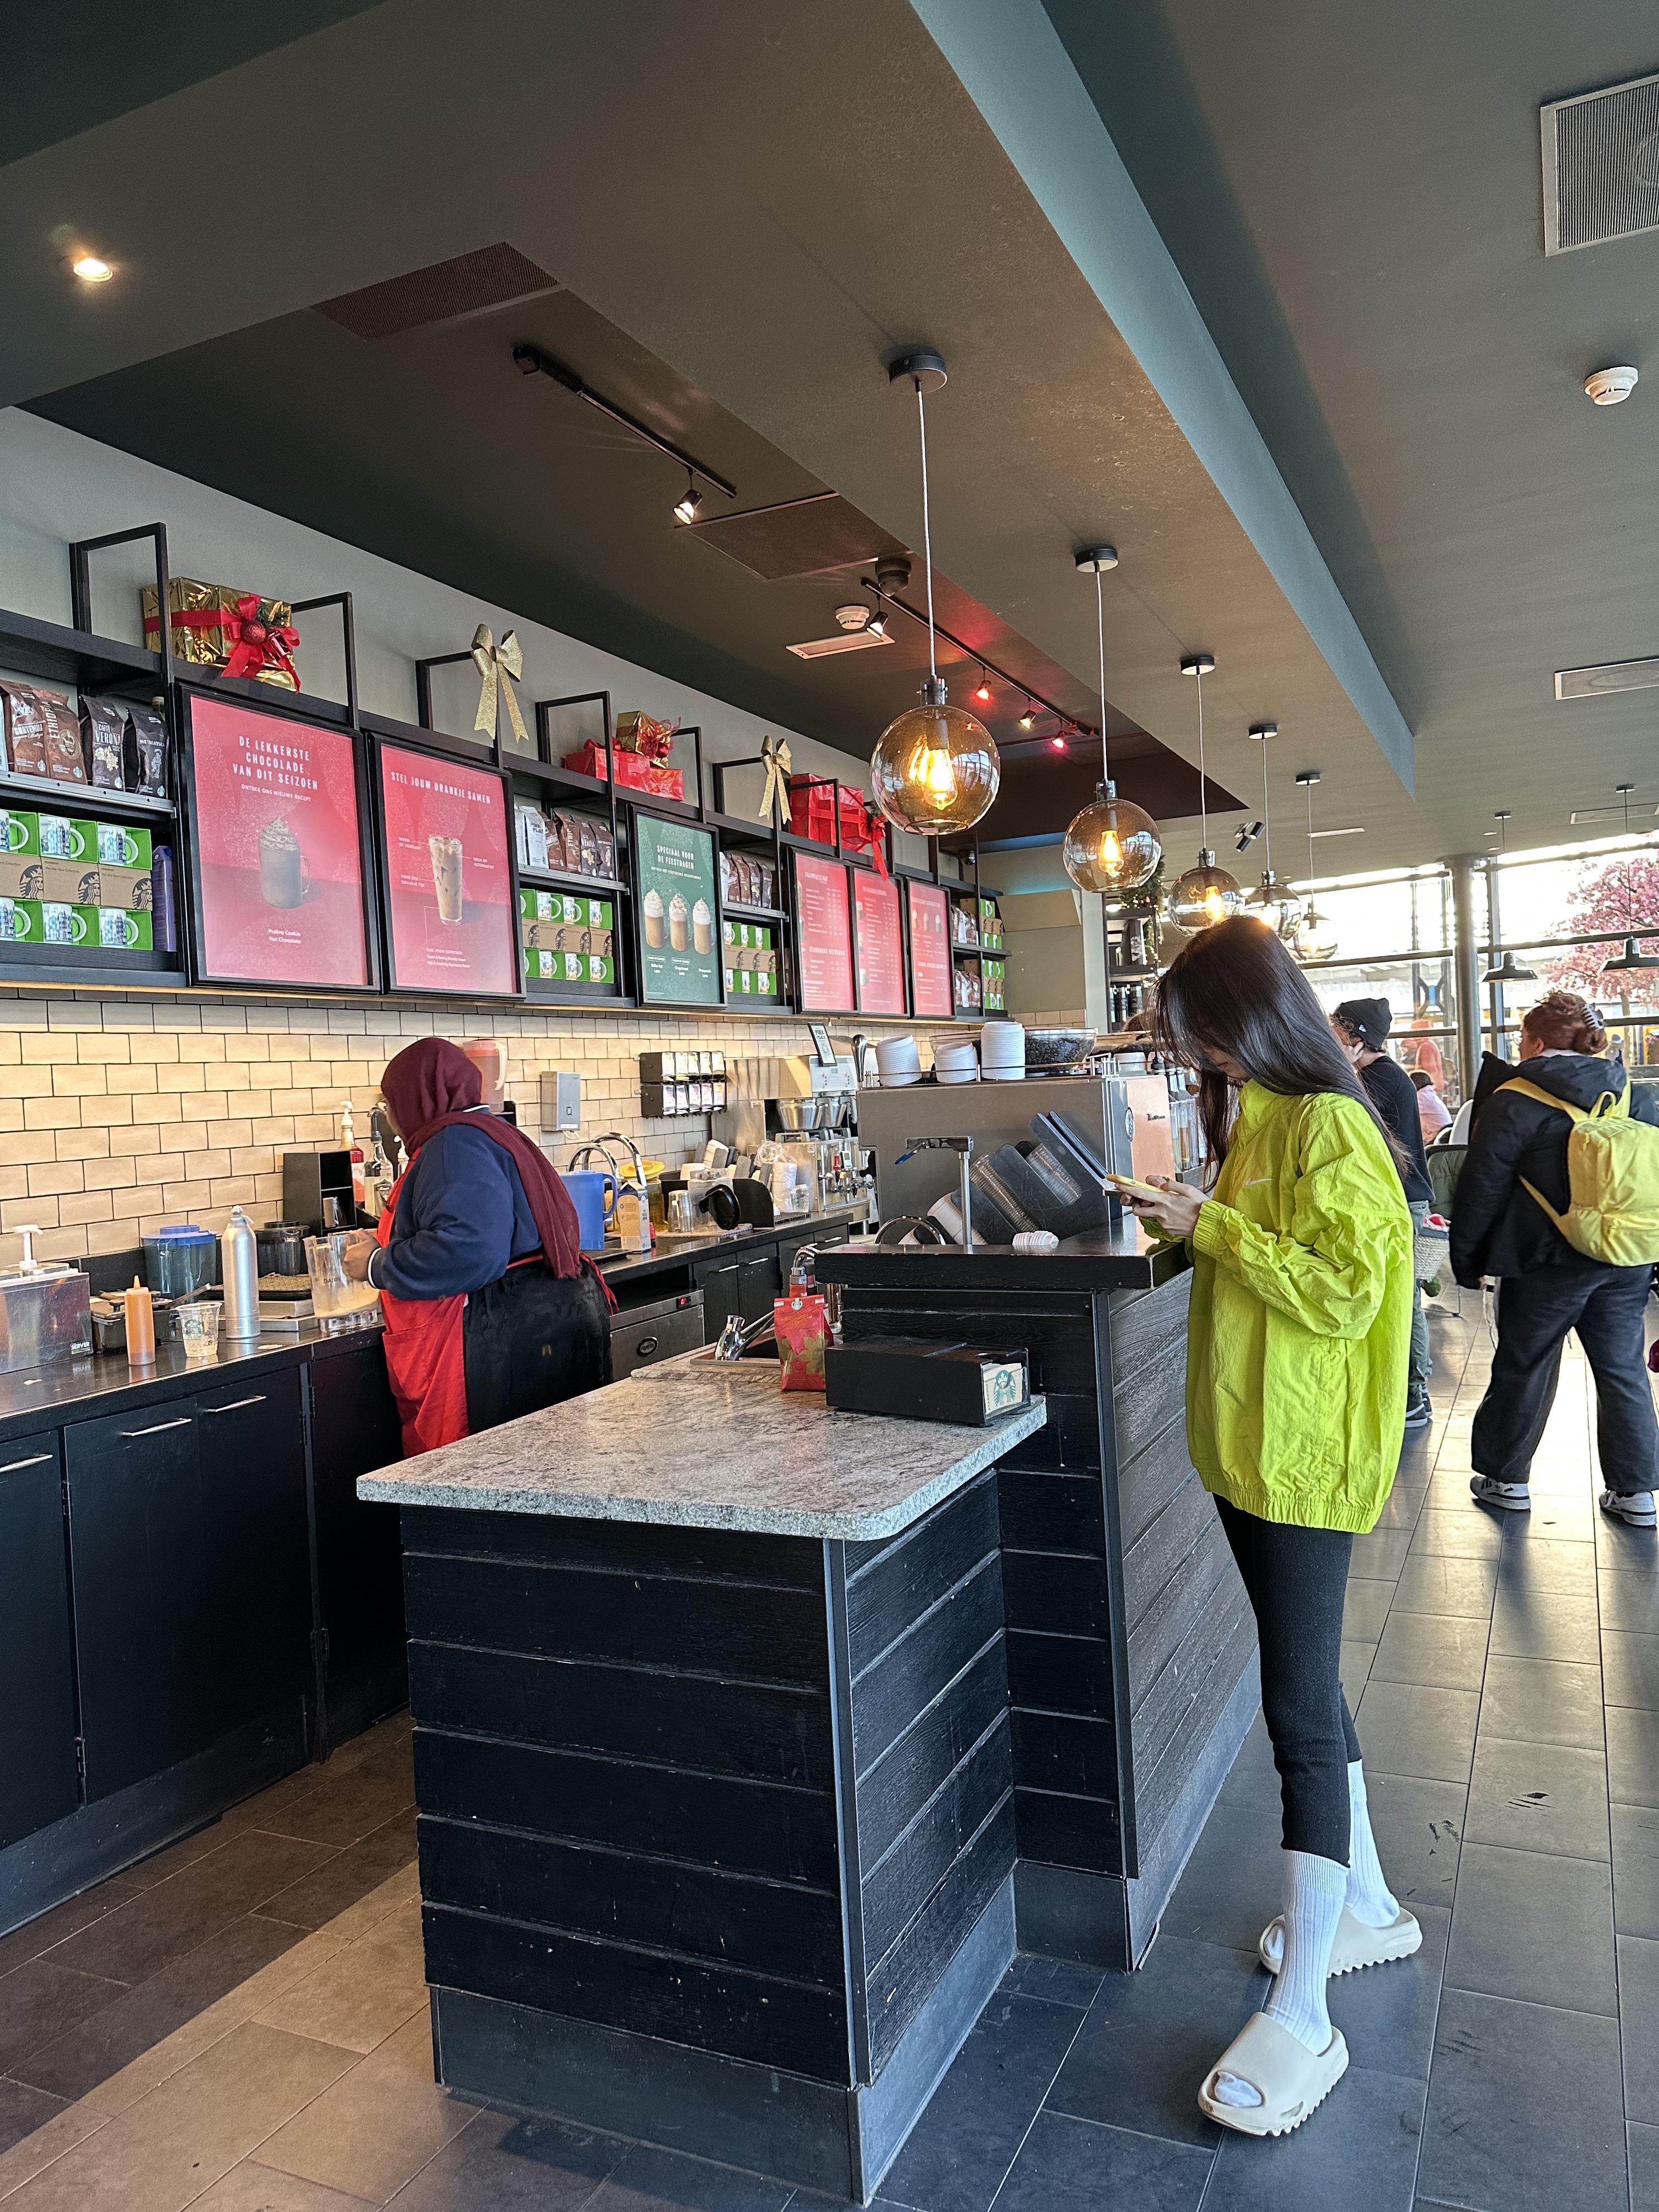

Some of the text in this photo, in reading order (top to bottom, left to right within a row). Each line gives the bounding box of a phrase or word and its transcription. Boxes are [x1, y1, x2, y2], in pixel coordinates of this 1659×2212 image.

[42, 701, 60, 738] ETHIOPIA
[239, 736, 309, 761] DE LEKKERSTE
[246, 752, 304, 774] CHOCOLADE
[233, 763, 318, 790] VAN DIT SEIZOEN
[391, 771, 491, 804] STEL JOUW DRANKJE SAMEN
[241, 784, 261, 793] ONTDEK
[274, 791, 294, 799] NIEUWE
[295, 794, 312, 802] RECEPT
[657, 844, 694, 860] SPECIAAL VOOR
[658, 855, 694, 870] DE FEESTDAGEN
[71, 1341, 91, 1350] SERVER
